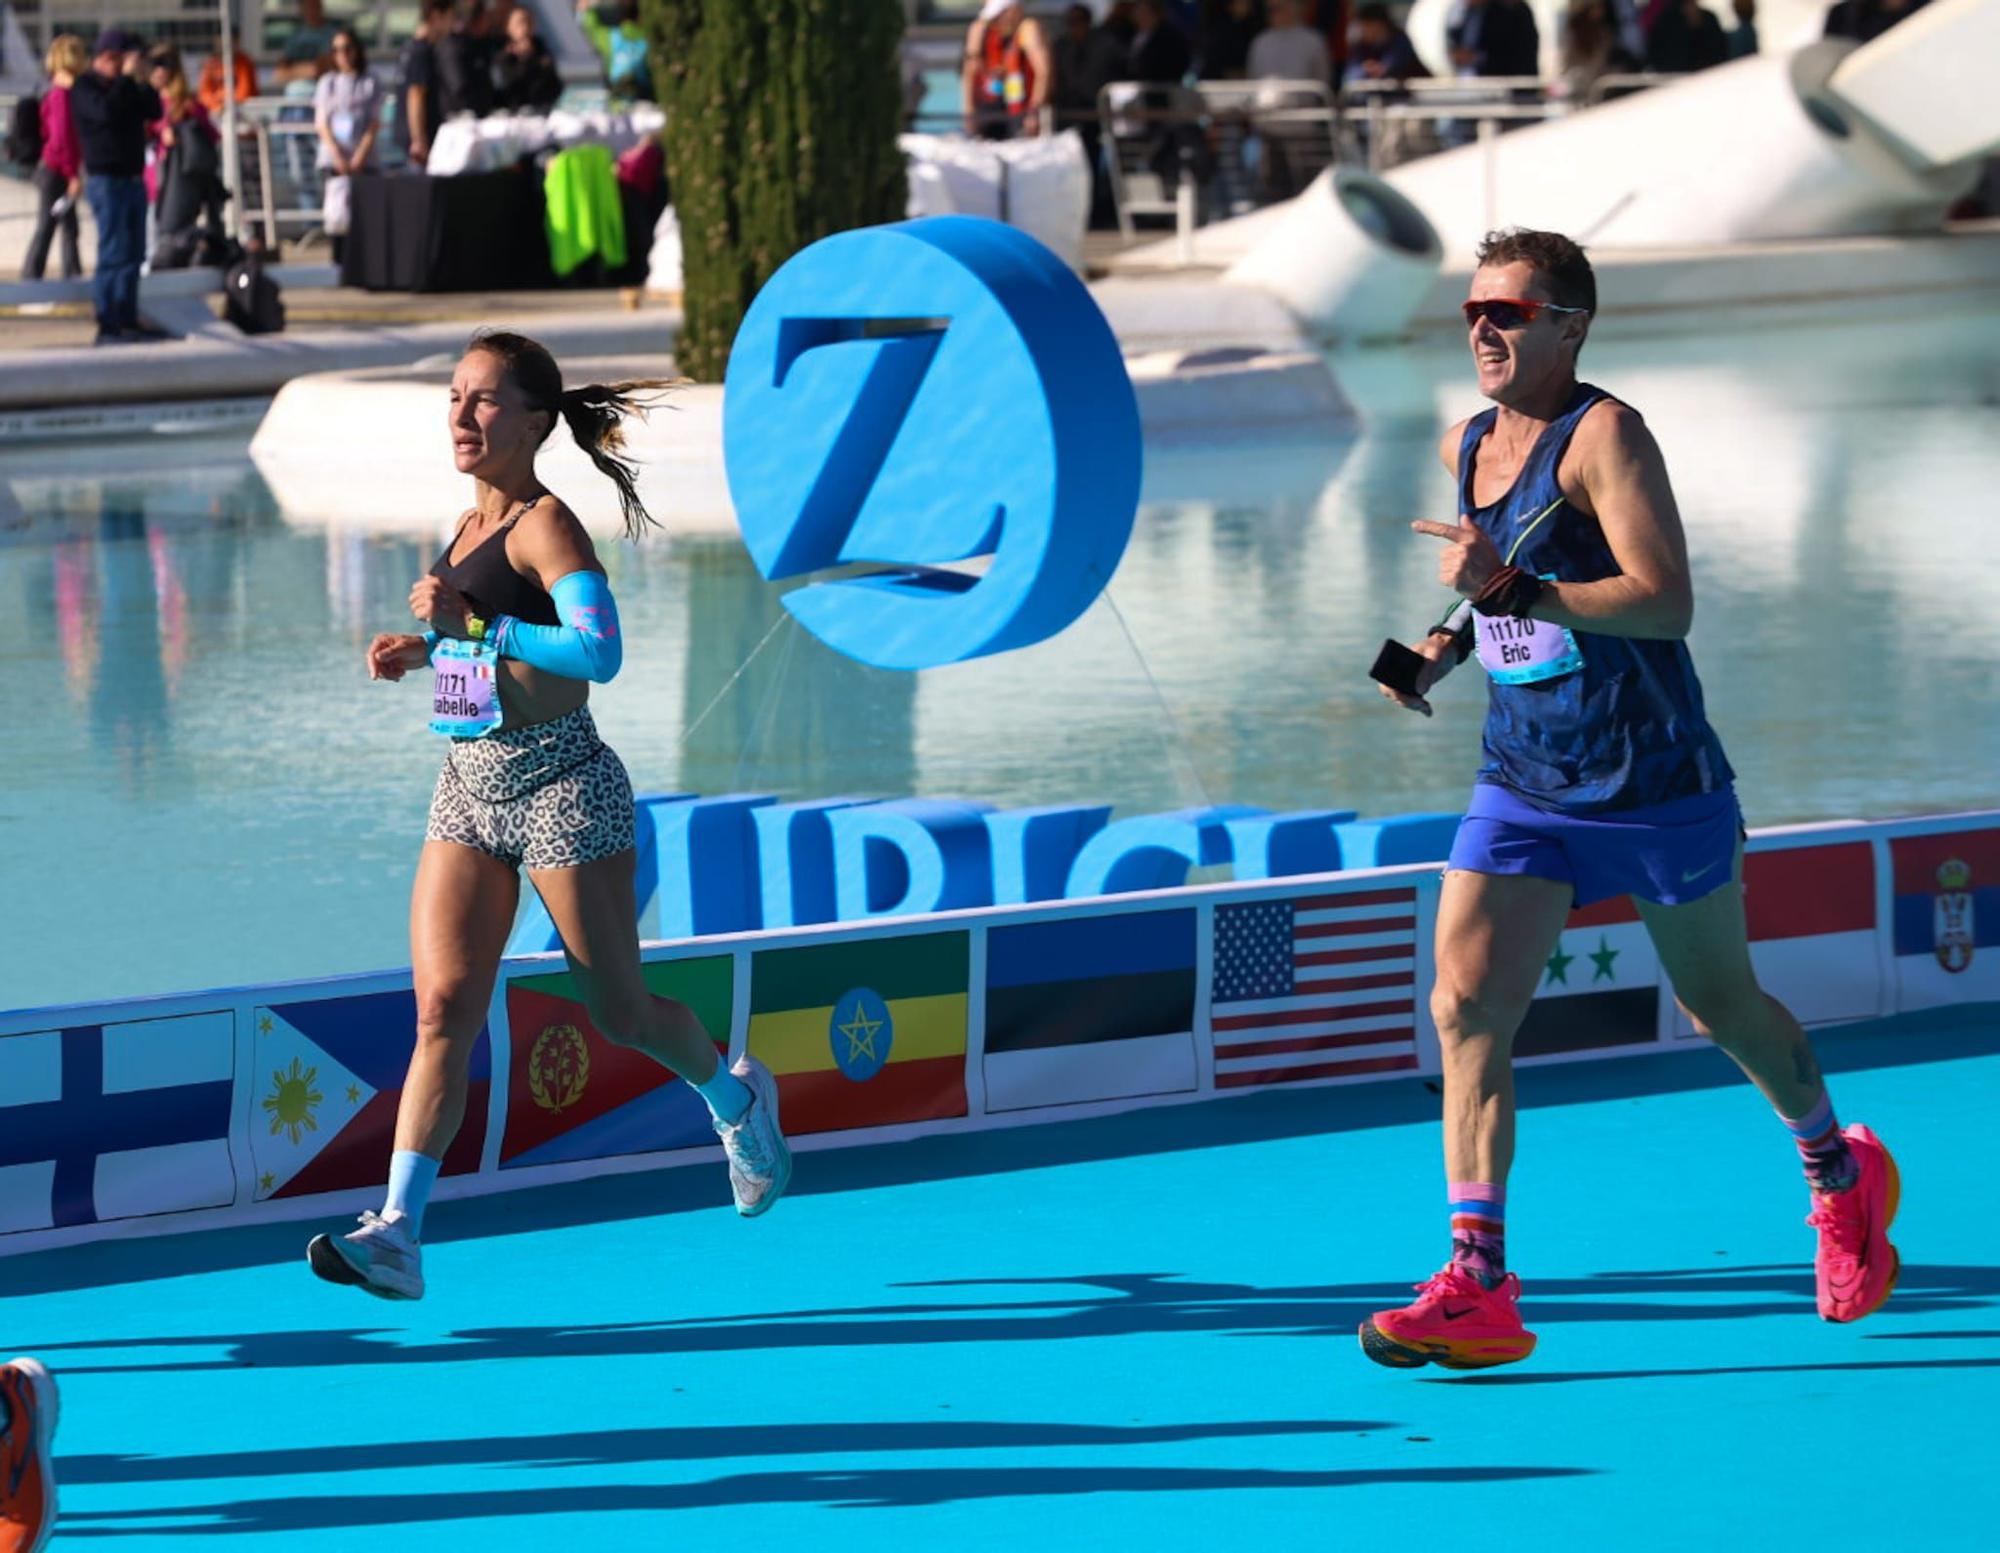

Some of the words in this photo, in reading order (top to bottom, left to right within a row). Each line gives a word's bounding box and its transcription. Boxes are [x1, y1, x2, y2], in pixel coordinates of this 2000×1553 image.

[771, 315, 1007, 595] Z
[1488, 618, 1535, 642] 11170
[1501, 643, 1531, 664] Eric
[434, 696, 480, 718] abelle
